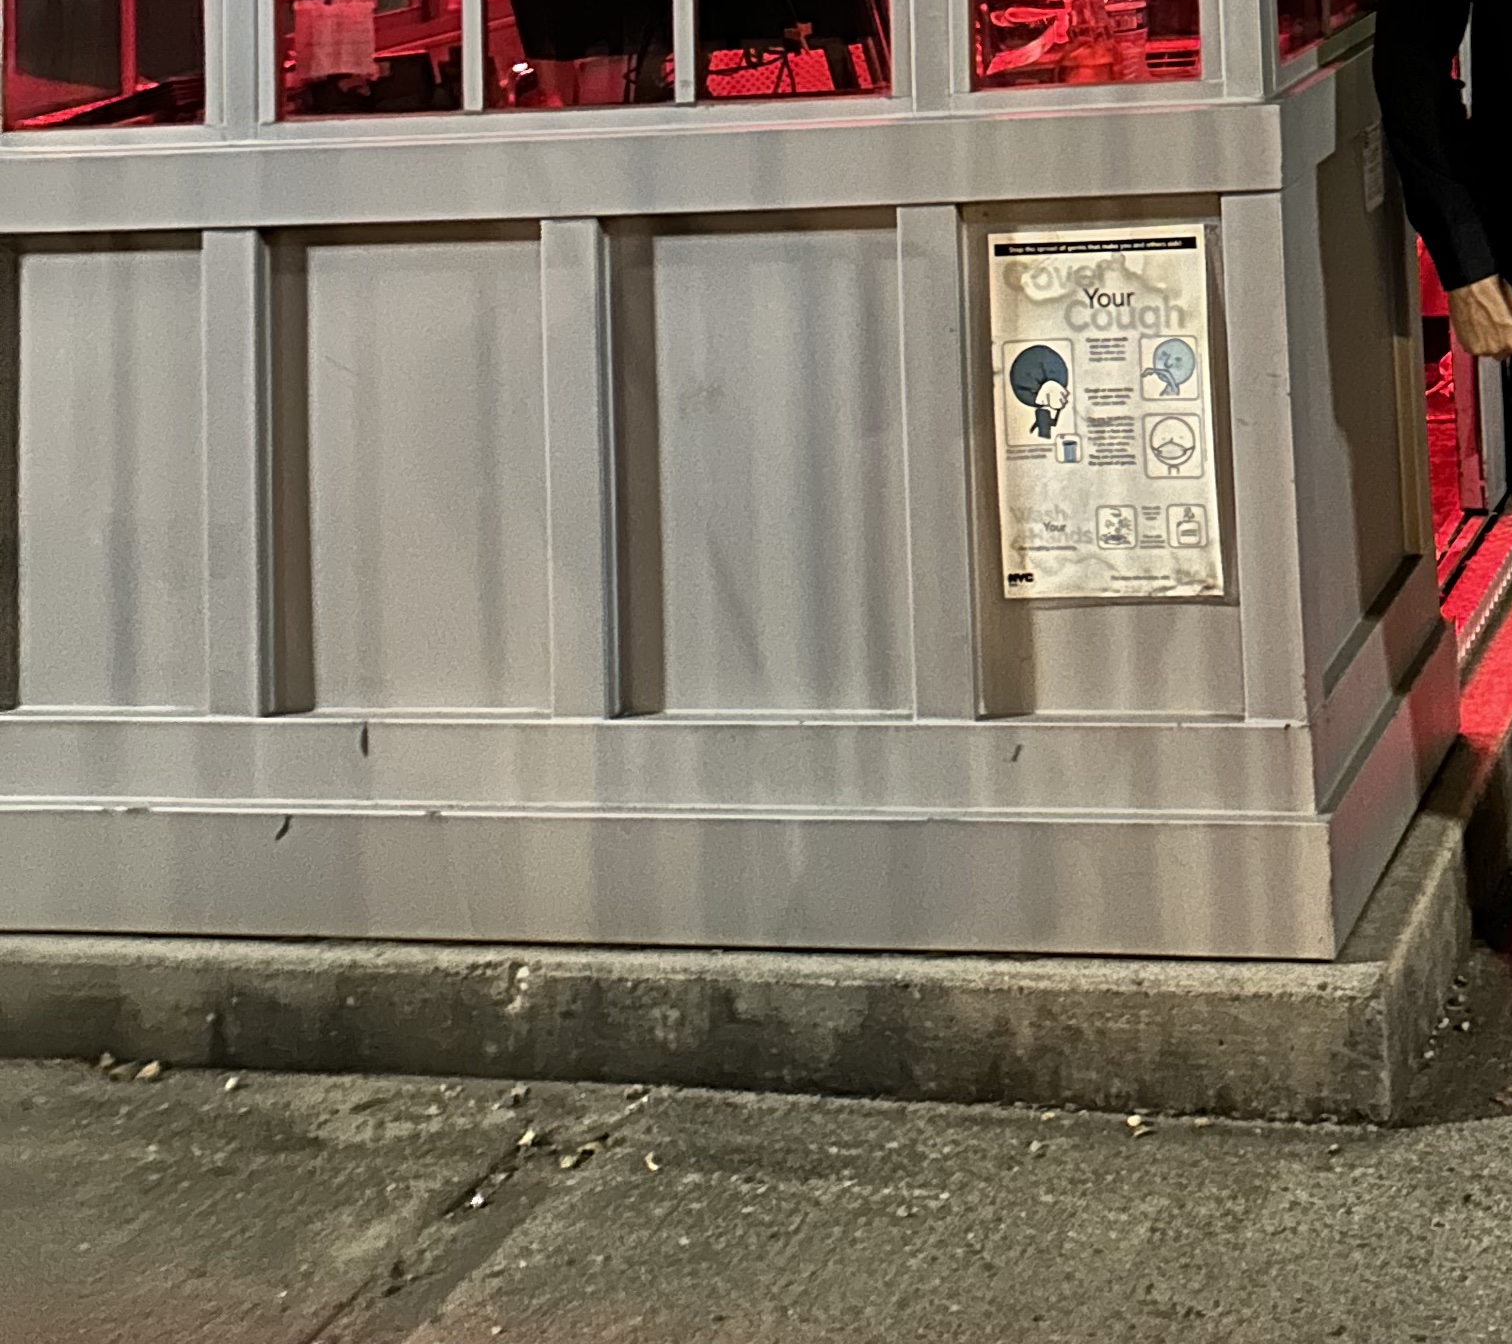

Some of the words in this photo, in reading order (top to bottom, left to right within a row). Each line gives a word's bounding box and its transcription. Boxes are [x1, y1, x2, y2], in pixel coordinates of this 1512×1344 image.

[1002, 259, 1112, 291] Cover
[1083, 288, 1135, 309] Your
[1064, 294, 1186, 336] Cough
[1042, 520, 1067, 533] Your
